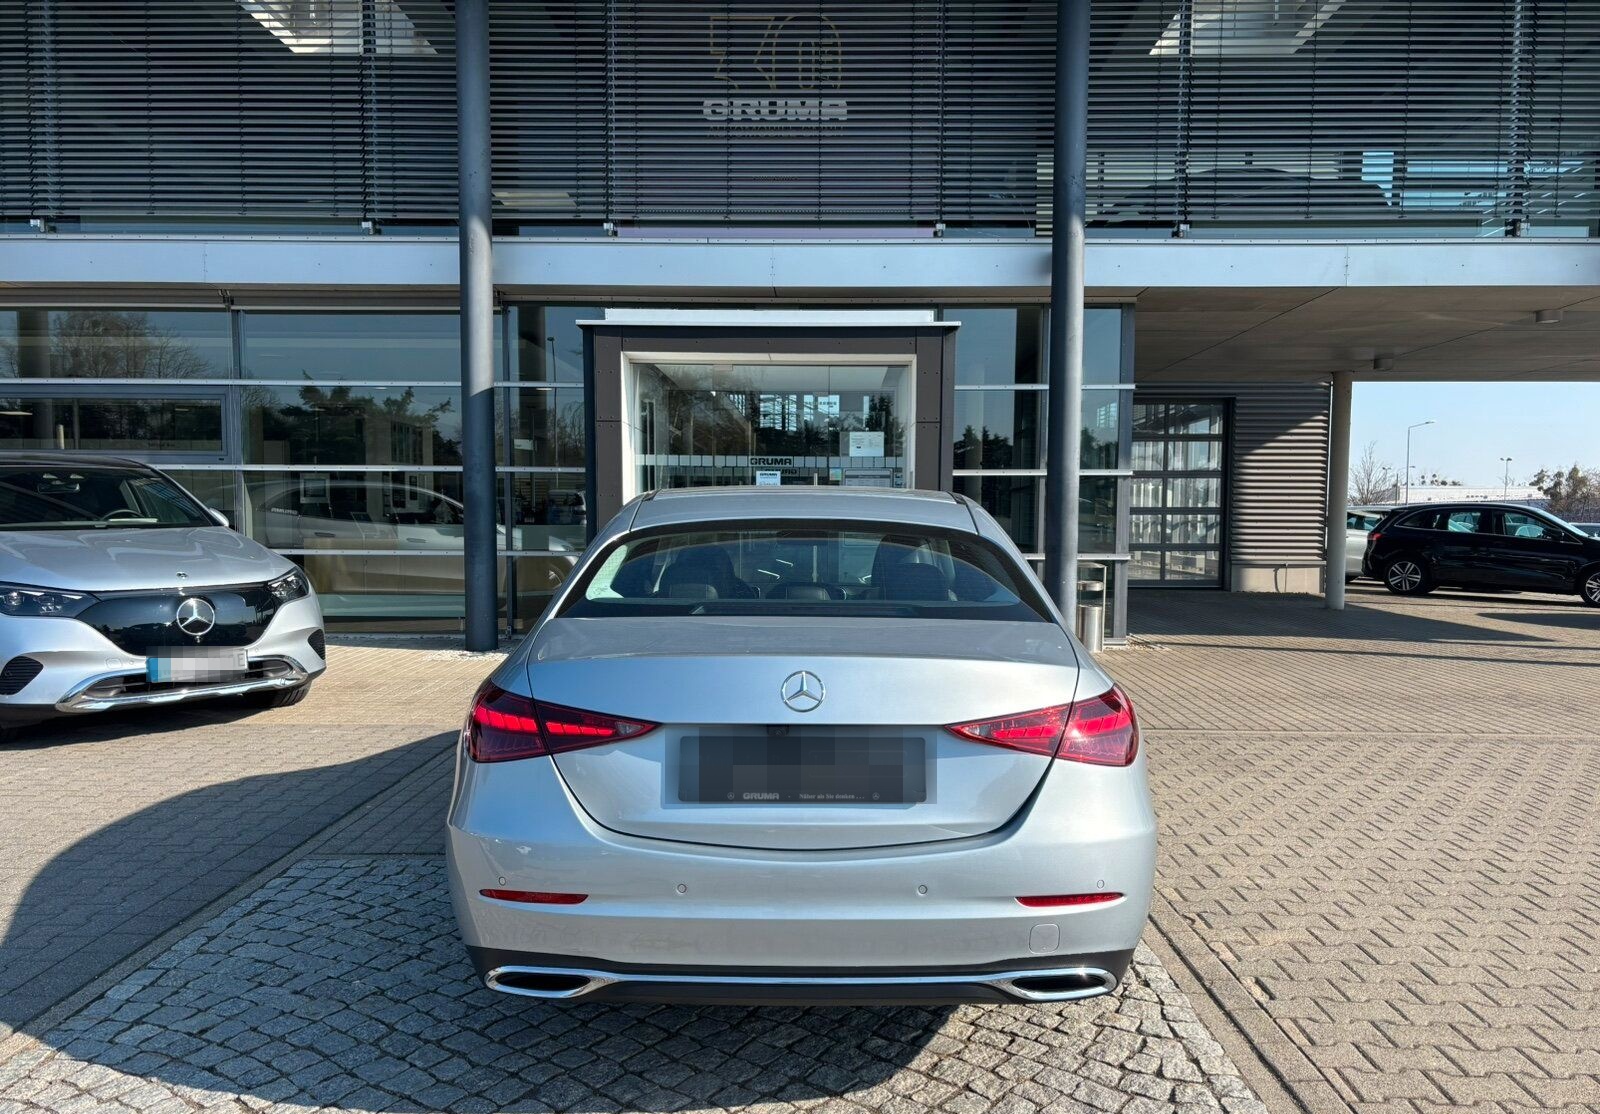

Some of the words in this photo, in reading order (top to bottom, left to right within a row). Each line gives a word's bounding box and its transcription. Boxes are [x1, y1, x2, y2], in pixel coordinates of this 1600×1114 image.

[703, 99, 848, 120] GRUMA
[750, 457, 792, 466] GRUMA
[742, 792, 780, 800] GRUMA
